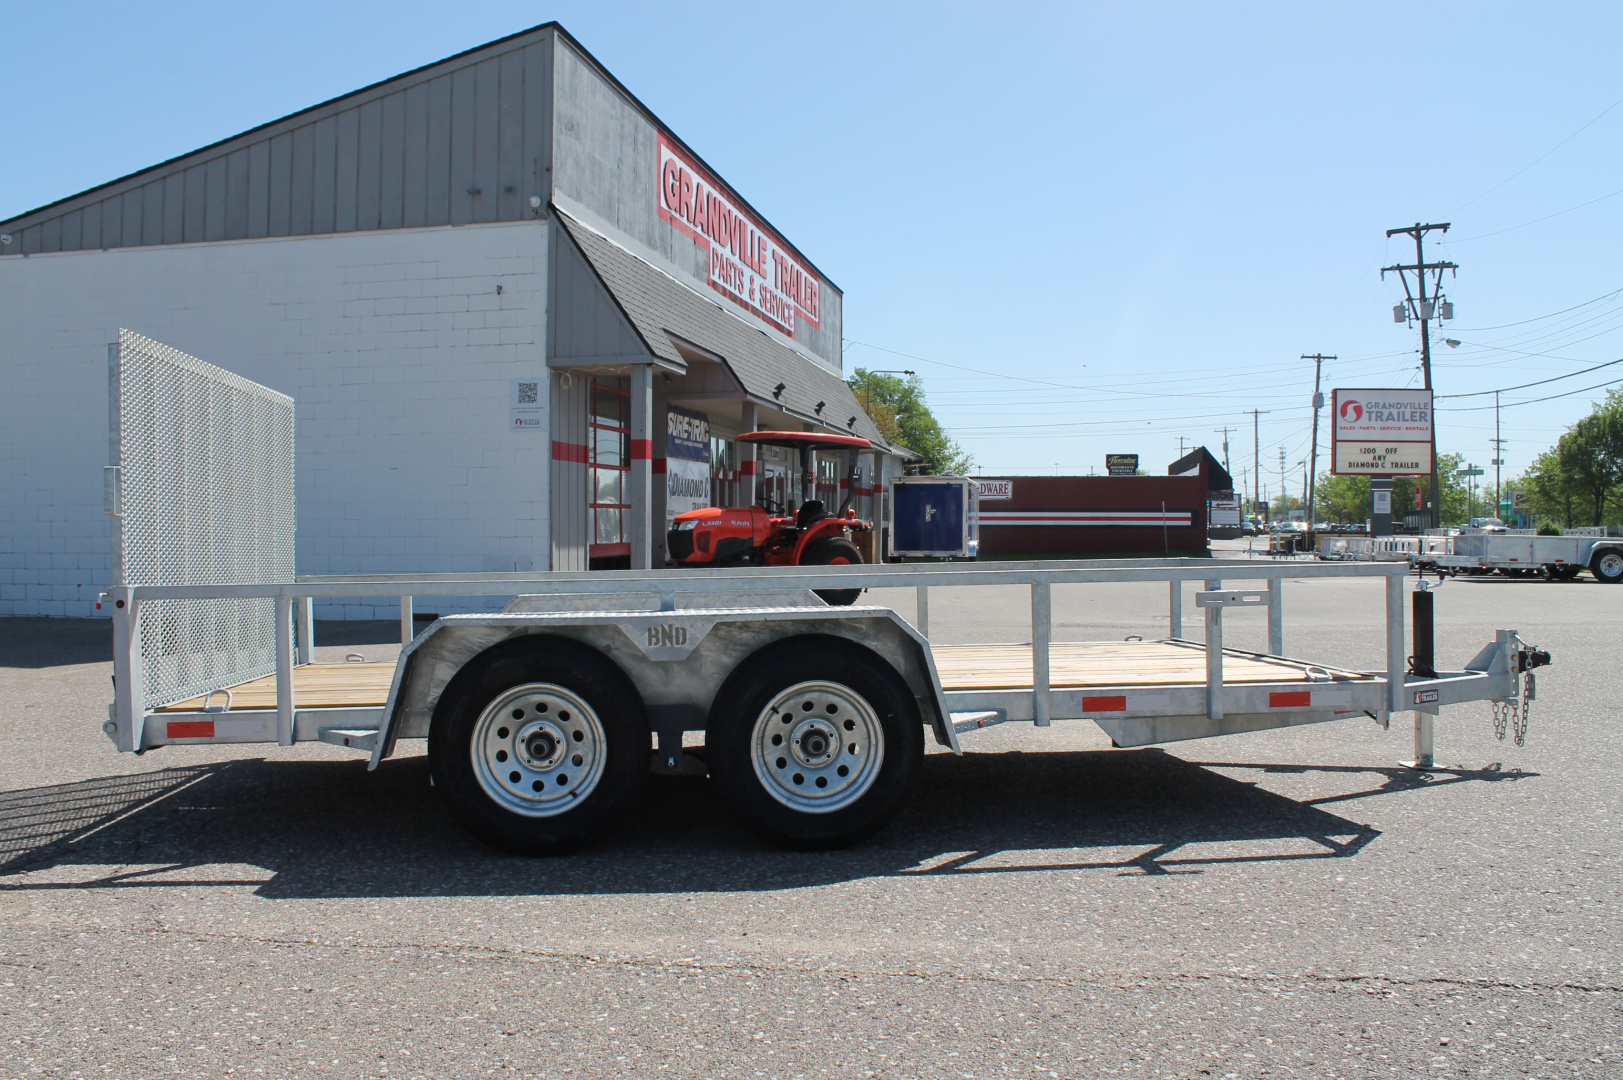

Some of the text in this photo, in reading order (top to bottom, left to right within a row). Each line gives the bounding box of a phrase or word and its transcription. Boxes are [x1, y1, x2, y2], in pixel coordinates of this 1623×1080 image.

[663, 157, 819, 318] GRANDVILLE TRAILER
[712, 246, 794, 329] PARTS & SERVICE
[1366, 401, 1429, 410] GRANDVILLE
[1366, 411, 1428, 422] TRAILER
[672, 473, 709, 498] DIAMOND C
[979, 483, 1009, 494] DWARE
[647, 623, 687, 647] BND
